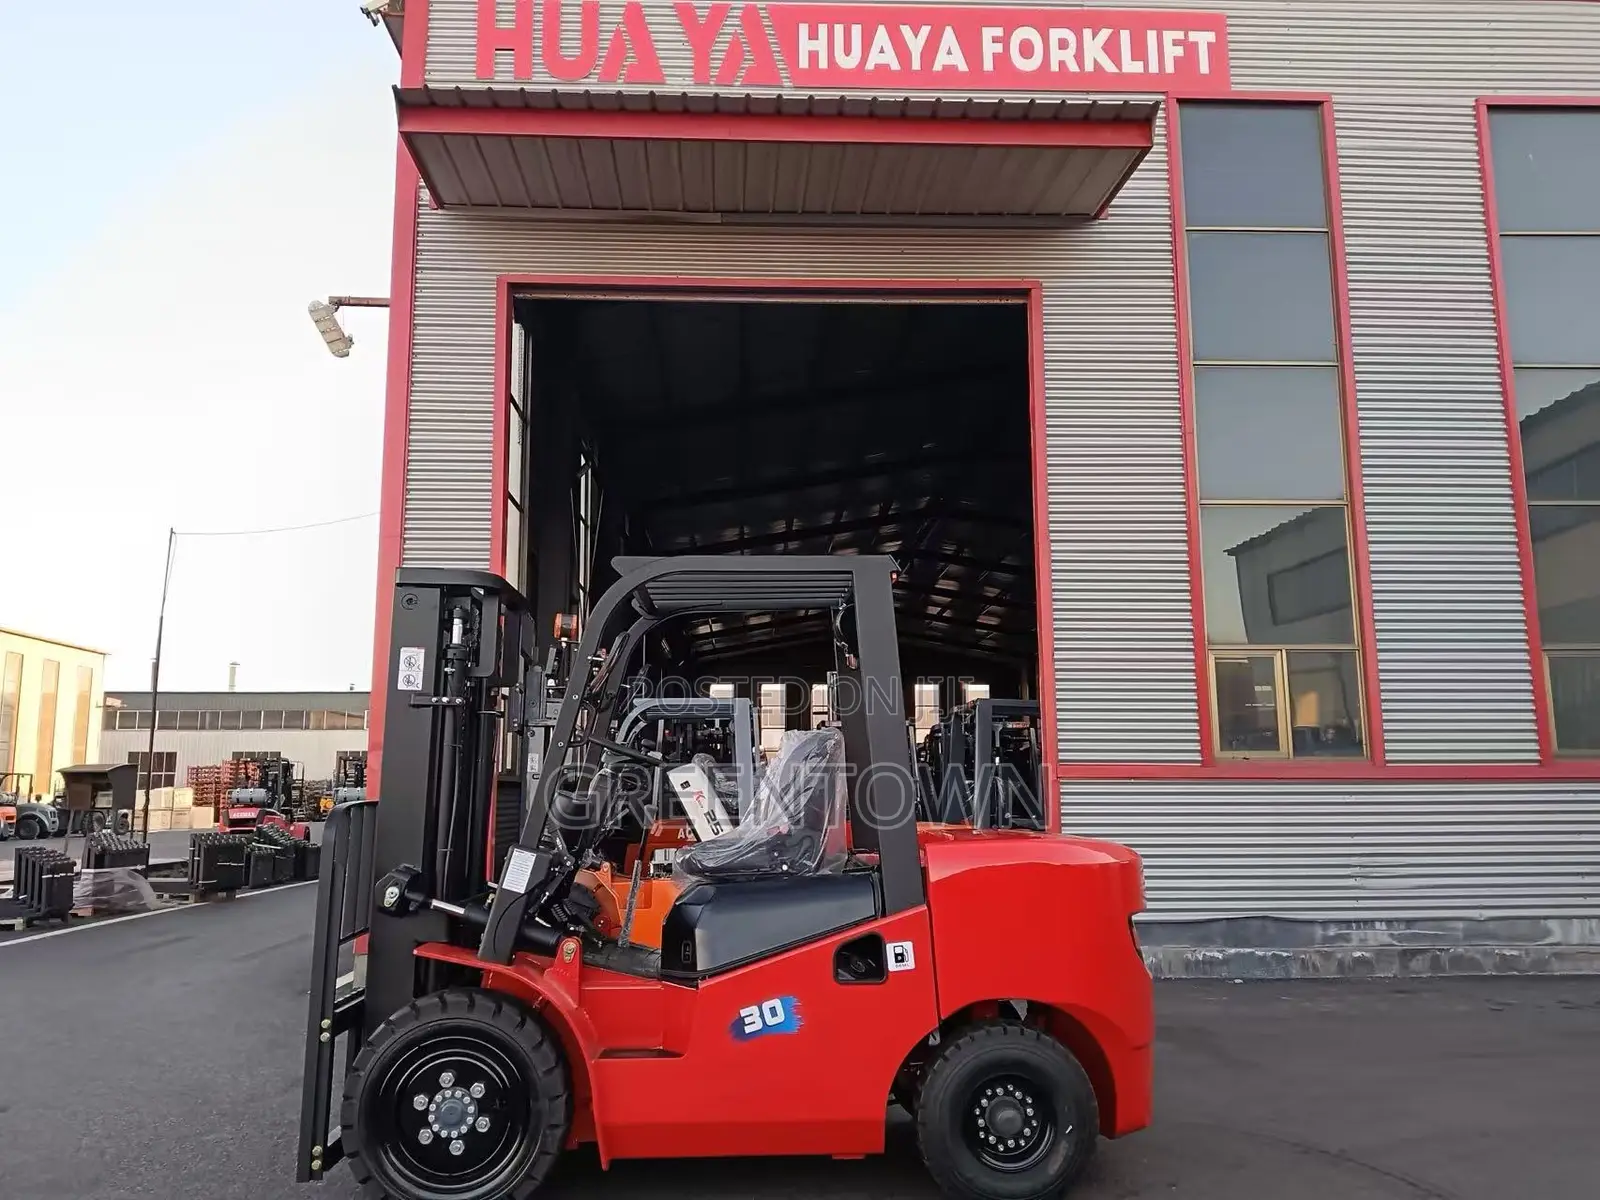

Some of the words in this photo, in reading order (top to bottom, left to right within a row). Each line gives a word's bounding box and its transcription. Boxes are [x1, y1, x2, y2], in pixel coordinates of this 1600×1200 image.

[475, 0, 785, 85] HUAYA
[797, 22, 969, 73] HUAYA
[981, 25, 1217, 76] FORKLIFT
[703, 808, 724, 836] 25
[739, 998, 785, 1034] 30
